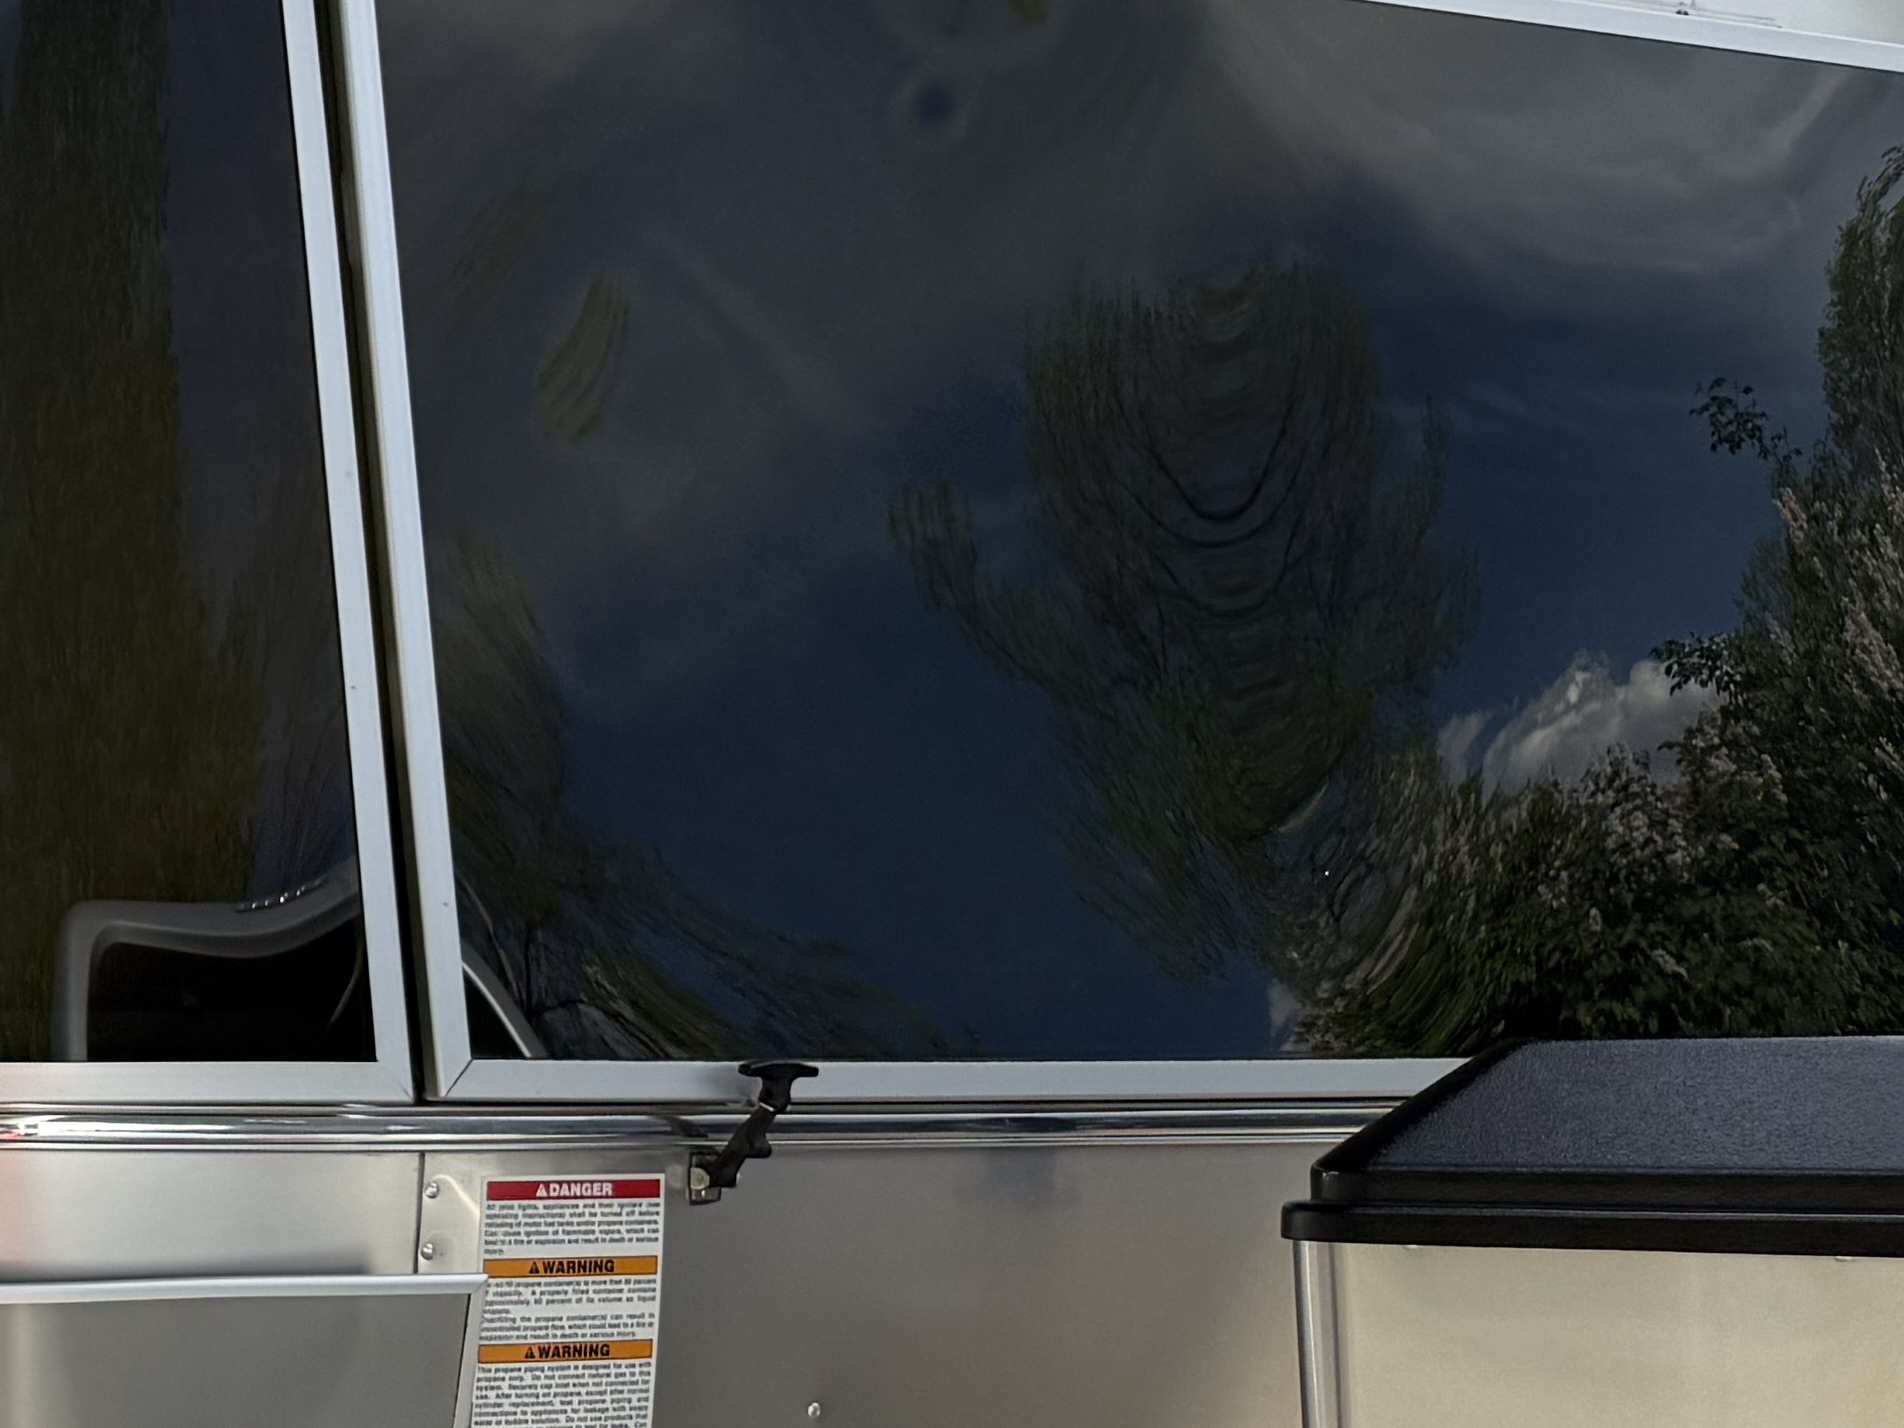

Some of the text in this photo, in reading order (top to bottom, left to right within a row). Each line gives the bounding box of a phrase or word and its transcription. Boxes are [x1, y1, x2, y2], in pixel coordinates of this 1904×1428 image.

[549, 1182, 613, 1197] DANGER
[542, 1259, 615, 1274] WARNING
[538, 1343, 610, 1359] WARNING
